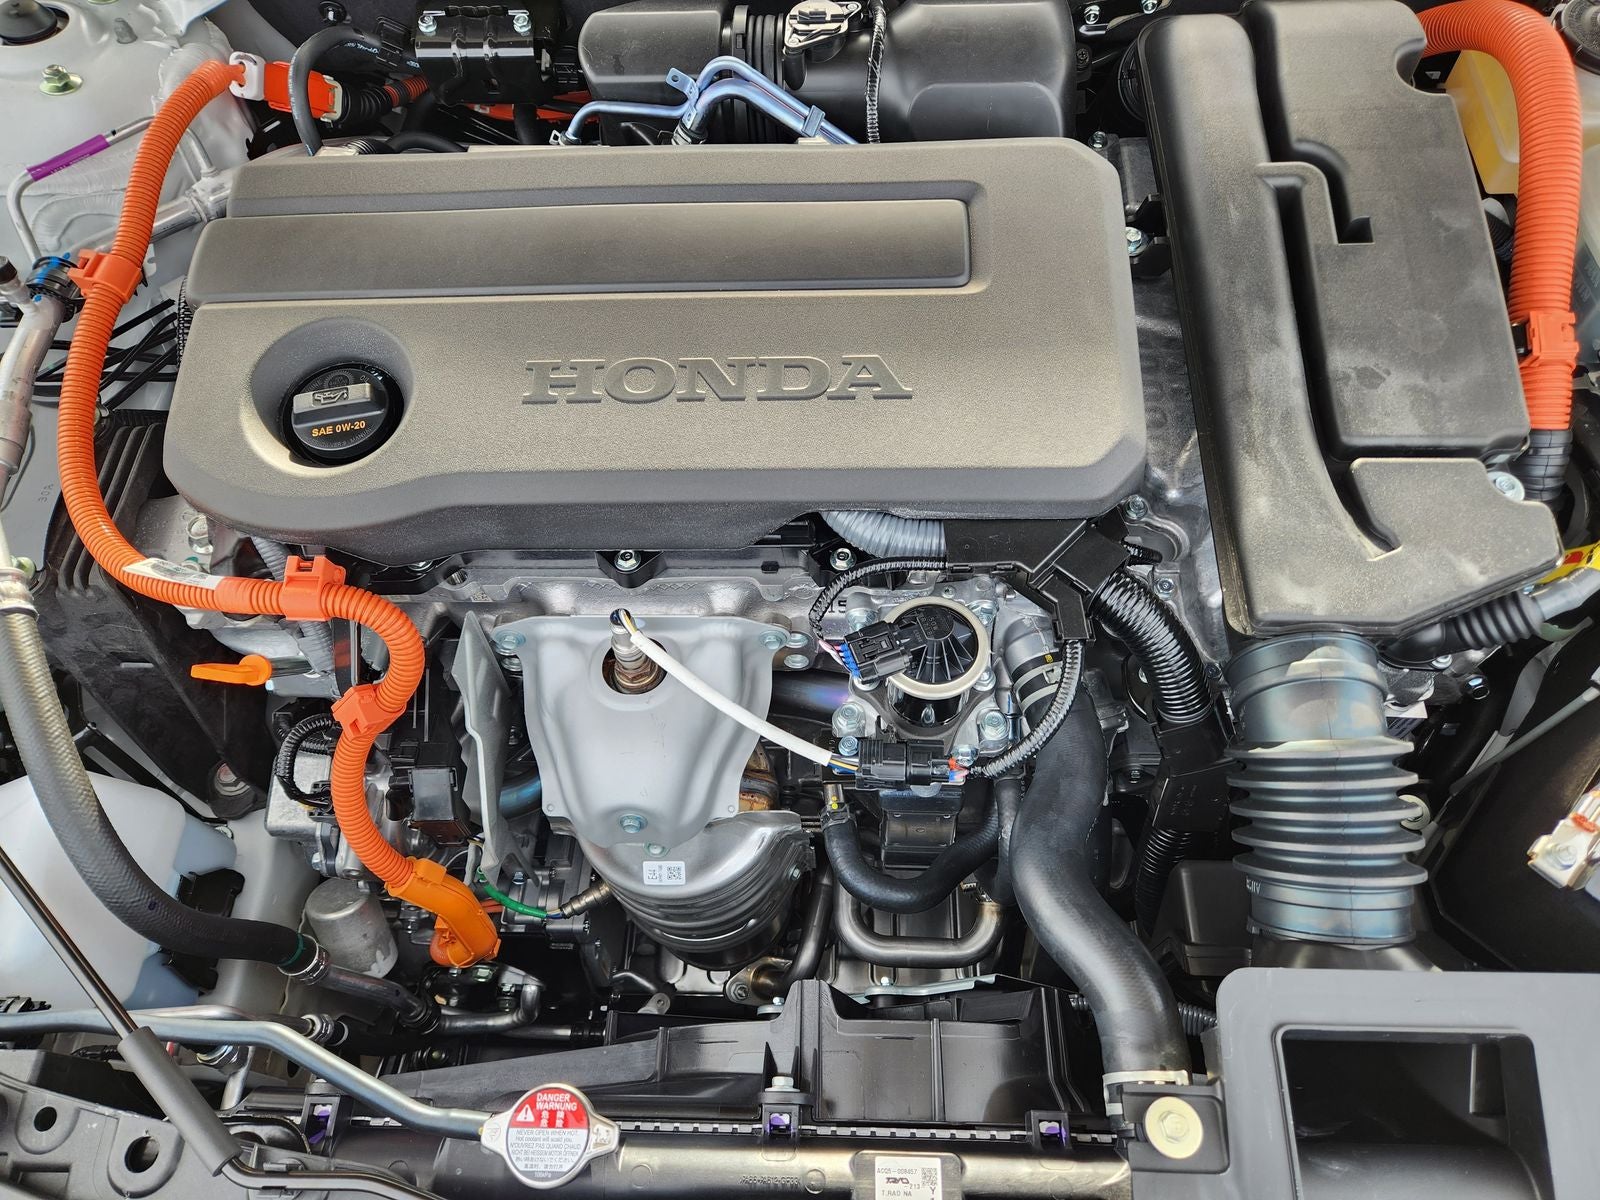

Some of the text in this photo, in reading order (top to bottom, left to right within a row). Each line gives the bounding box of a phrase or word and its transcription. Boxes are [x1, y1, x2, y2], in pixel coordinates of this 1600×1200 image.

[522, 354, 912, 404] HONDA
[312, 420, 366, 437] SAE 0W-20
[537, 1093, 570, 1102] DANGER
[536, 1102, 577, 1111] WARNUNG
